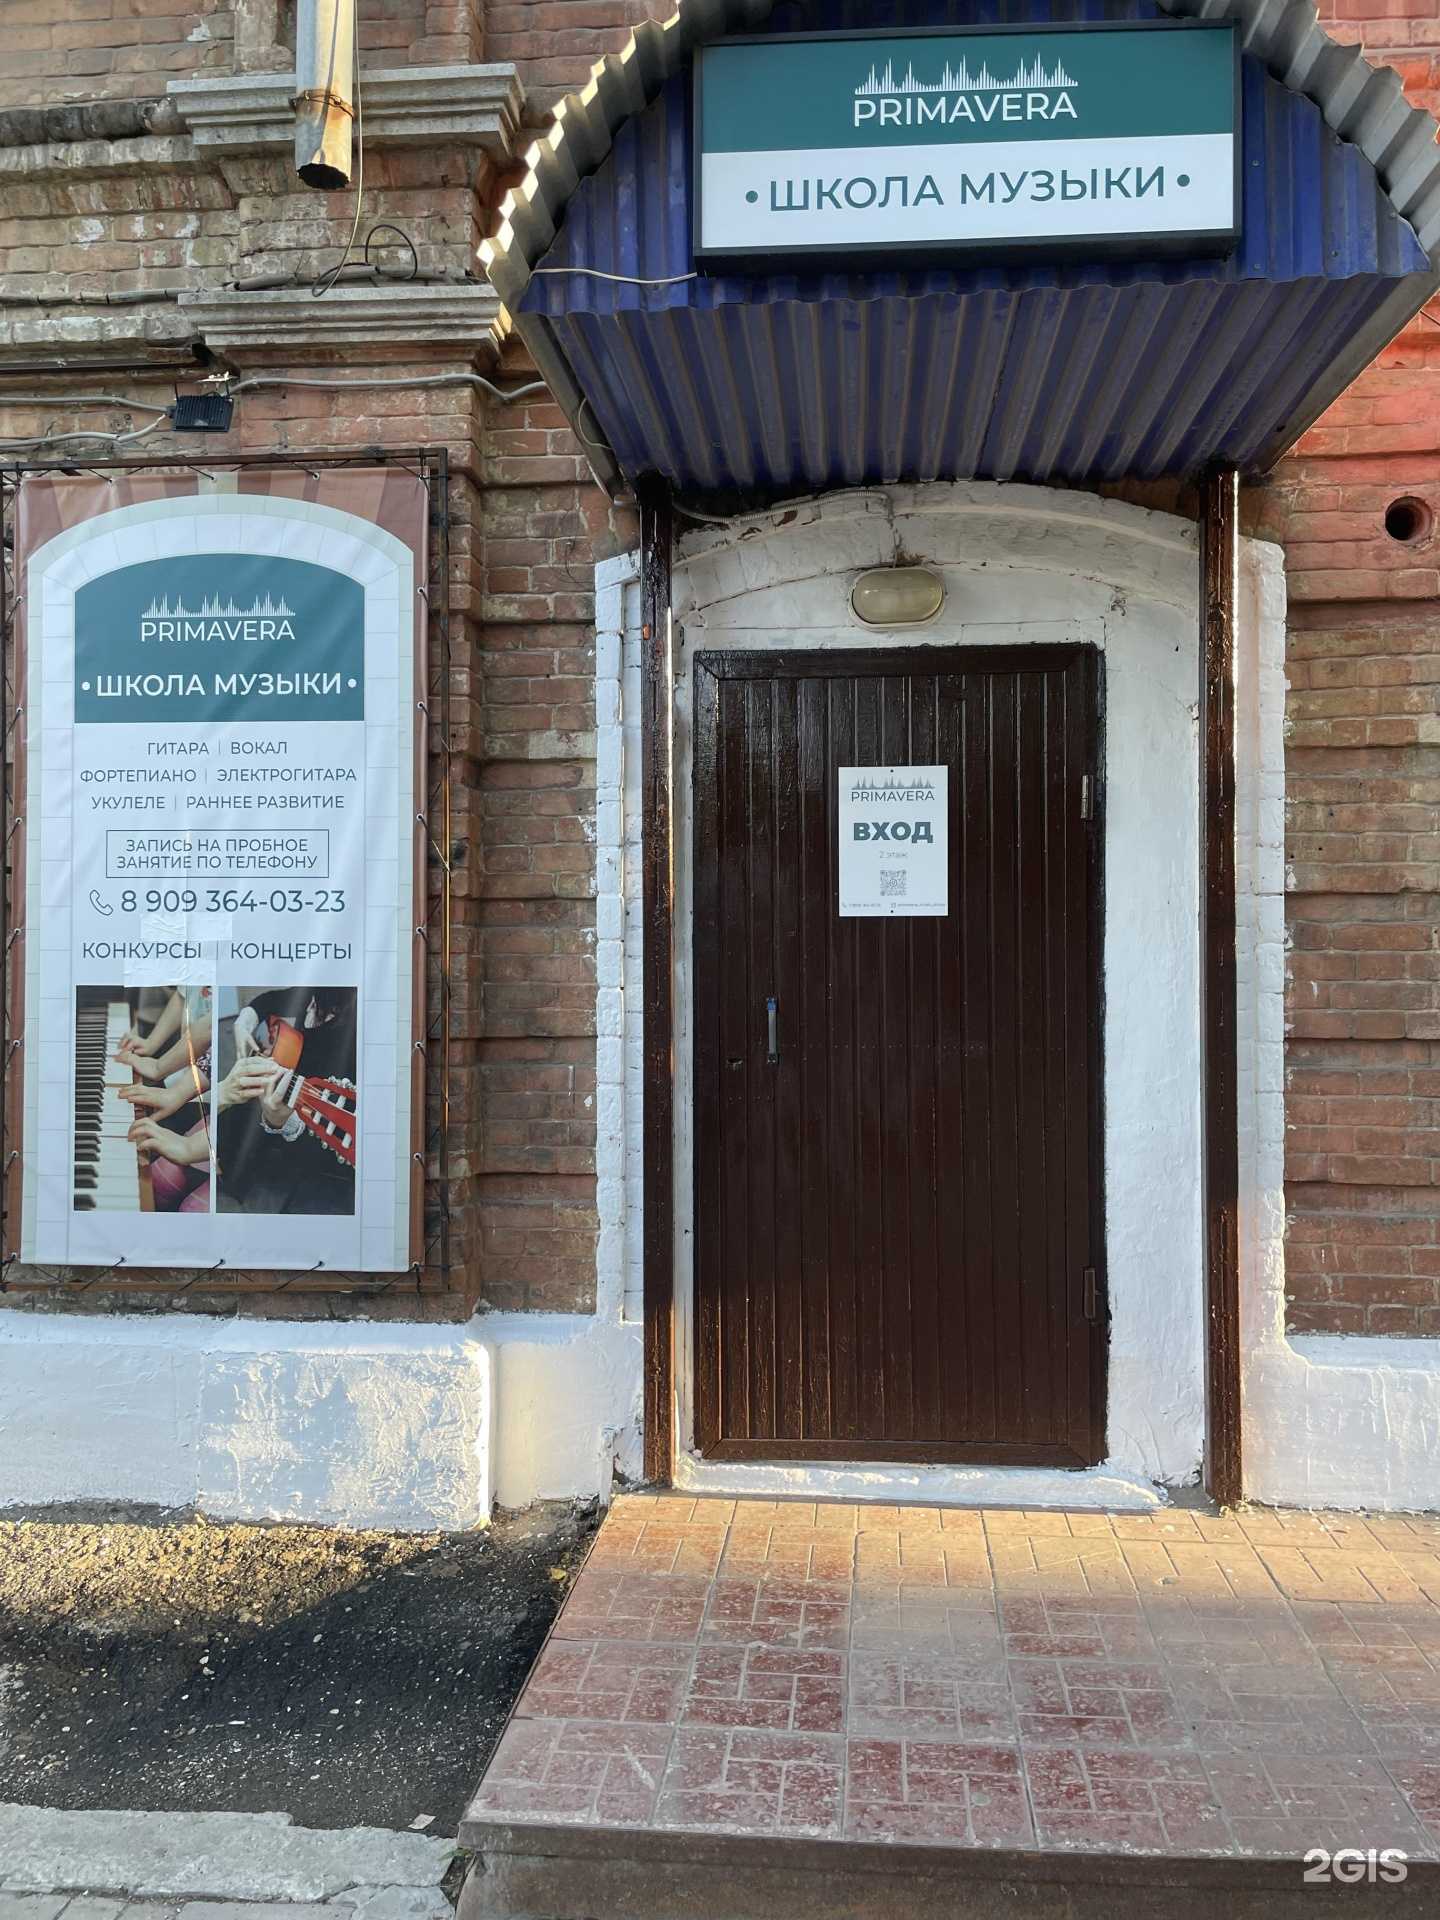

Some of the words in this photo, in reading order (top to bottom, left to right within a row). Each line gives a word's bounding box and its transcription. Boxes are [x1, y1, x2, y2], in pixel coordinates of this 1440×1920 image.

[854, 91, 1078, 127] PRIMAVERA
[769, 174, 945, 212] ШКОЛА
[959, 165, 1166, 205] МУЗЫКИ
[140, 619, 296, 642] PRIMAVERA
[97, 674, 206, 697] ШКОЛА
[215, 672, 342, 695] МУЗЫКИ
[147, 742, 210, 756] ГИТАРА
[230, 741, 287, 755] ВОКАЛ
[80, 769, 197, 783] ФОРТЕПИАНО
[216, 768, 357, 782] ЭЛЕКТРОГИТАРА
[91, 796, 166, 810] УКУЛЕЛЕ
[186, 796, 253, 809] РАННЕЕ
[257, 795, 345, 809] РАЗВИТИЕ
[851, 790, 936, 803] PRIMAVERA
[853, 821, 934, 844] ВХОД
[126, 839, 193, 853] ЗАПИСЬ
[198, 839, 222, 852] НА
[225, 838, 309, 852] ПРОБНОЕ
[116, 856, 192, 869] ЗАНЯТИЕ
[196, 855, 222, 869] ПО
[225, 855, 318, 869] ТЕЛЕФОНУ
[120, 890, 137, 913] 8
[145, 889, 198, 913] 909
[205, 889, 346, 913] 364-03-23
[82, 942, 201, 959] КОНКУРСЫ
[230, 943, 352, 963] КОНЦЕРТЫ
